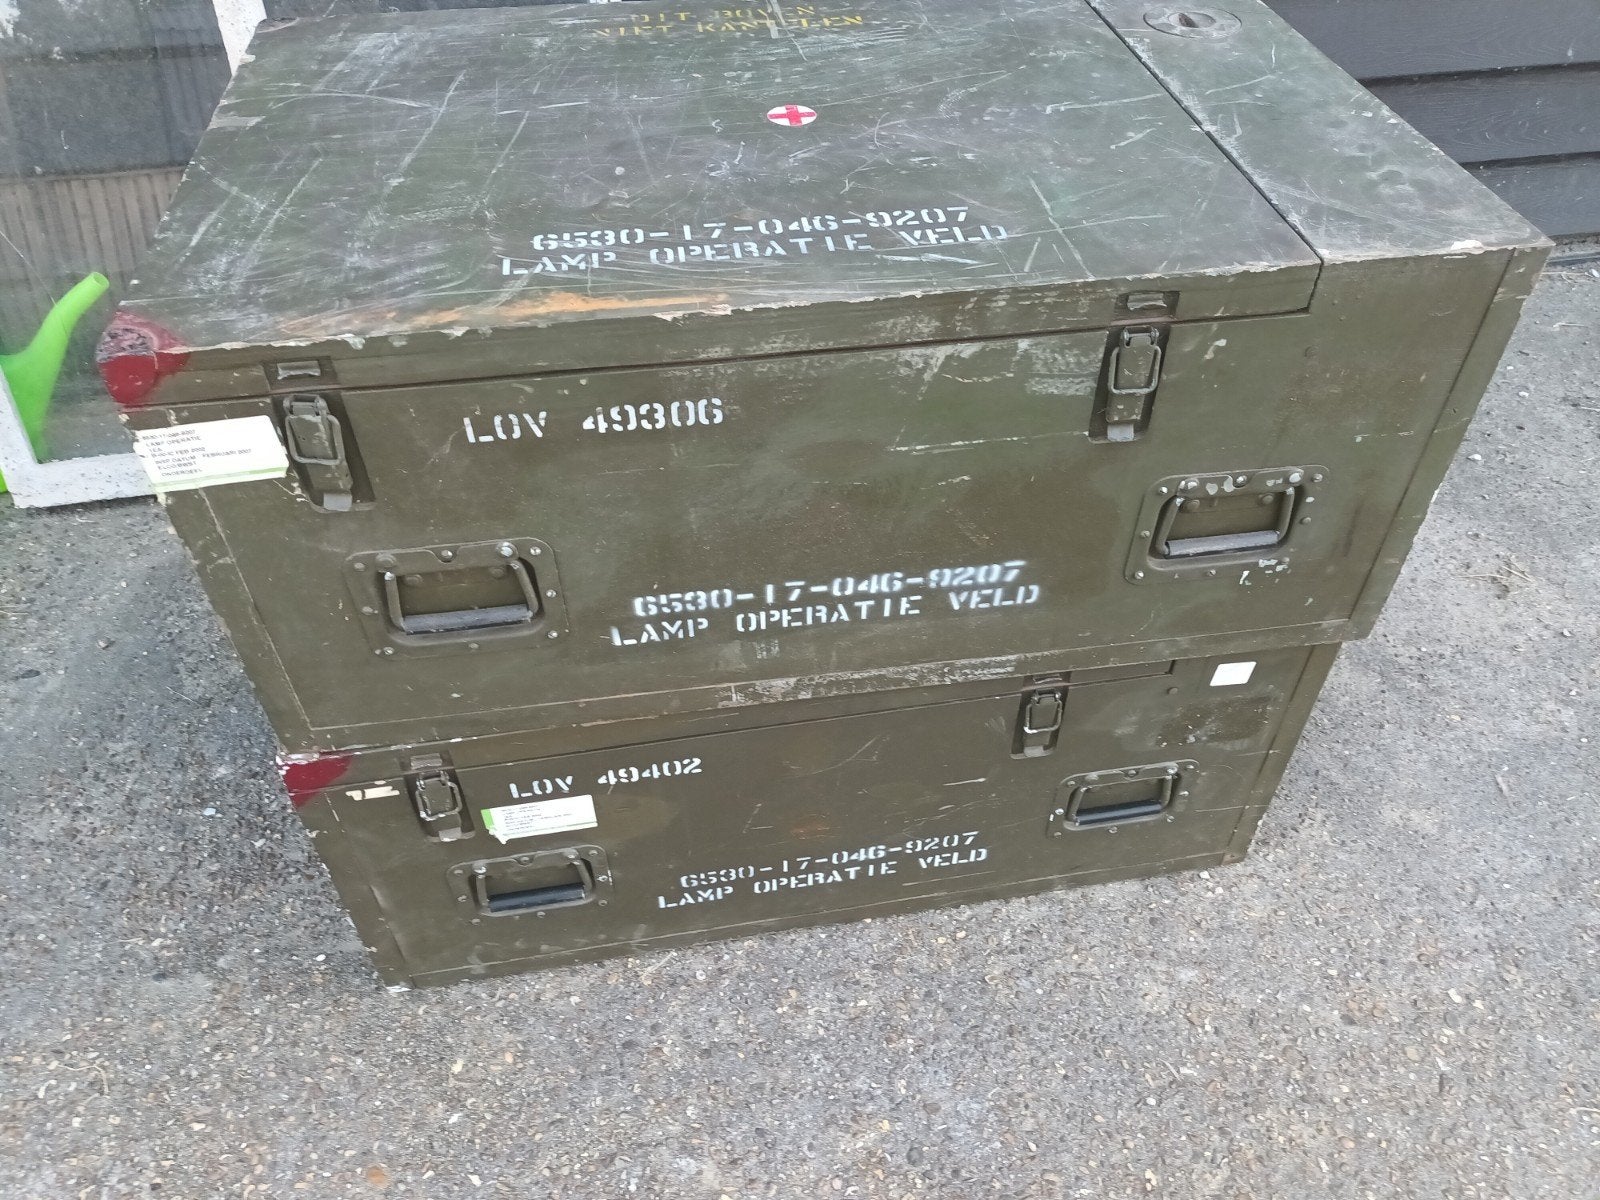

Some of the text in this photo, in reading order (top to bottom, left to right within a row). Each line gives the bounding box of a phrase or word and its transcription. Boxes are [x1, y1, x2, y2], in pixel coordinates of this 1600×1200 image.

[501, 224, 1009, 277] LAMP OPERATIE VELD
[532, 205, 970, 251] 6530-17-046-9207
[463, 397, 724, 444] LOV 49306
[609, 583, 1041, 648] LAMP OPERATIE VELD
[632, 560, 1027, 618] 6530-17-046-9207
[508, 757, 703, 799] LOV 49402
[657, 848, 988, 910] LAMP OPERATIE VELD
[680, 830, 980, 889] 6530-17-046-9207
